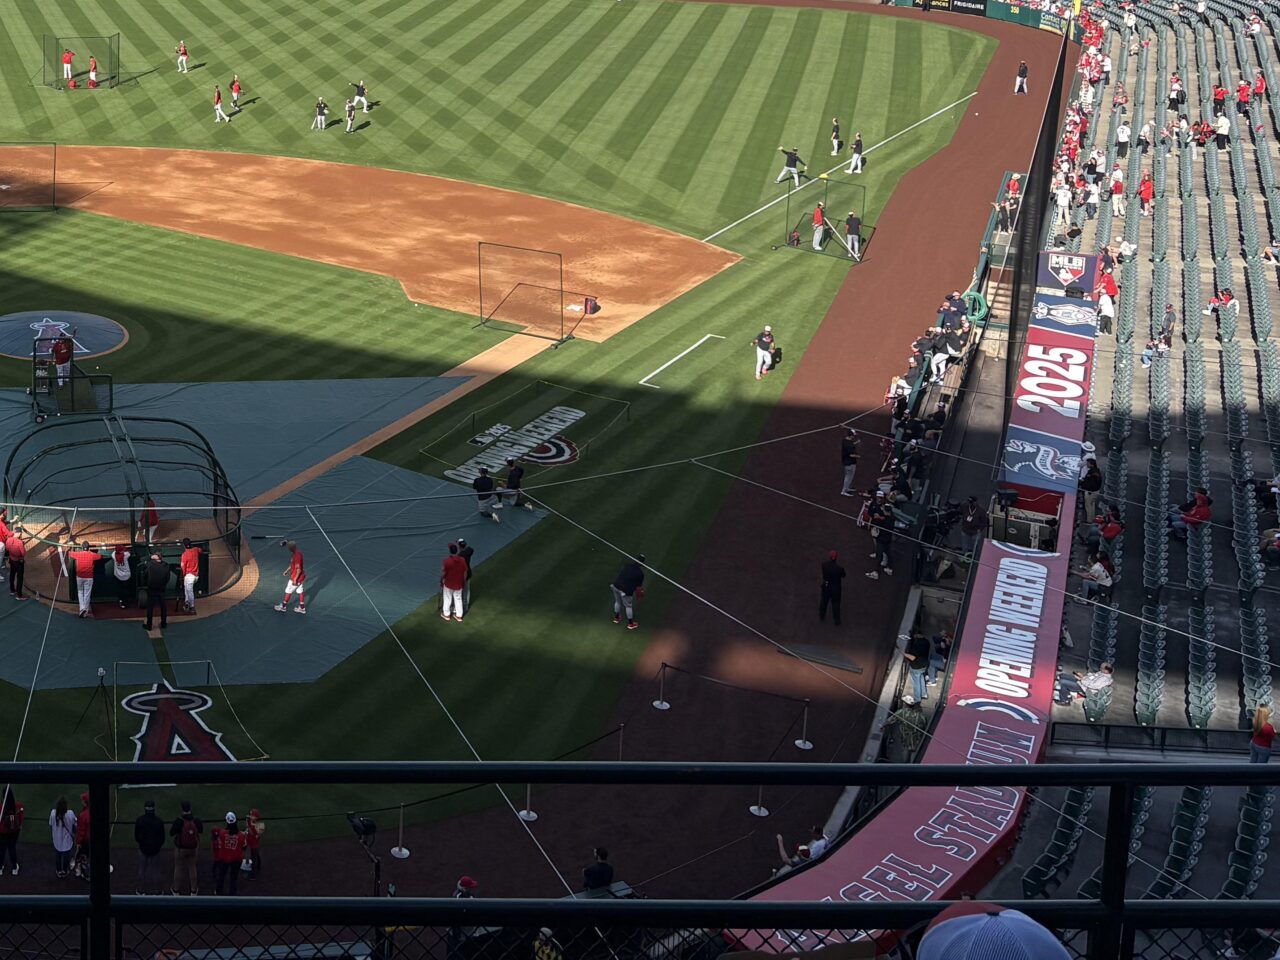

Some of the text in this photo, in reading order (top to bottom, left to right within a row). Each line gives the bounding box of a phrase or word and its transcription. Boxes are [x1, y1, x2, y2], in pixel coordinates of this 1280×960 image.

[953, 0, 985, 10] FRIGIDAIRE
[1010, 6, 1019, 14] 350
[1051, 256, 1083, 267] MLB
[1016, 344, 1088, 419] 2025
[974, 557, 1048, 698] OPENING WEEKEND
[914, 721, 1036, 861] STADUM
